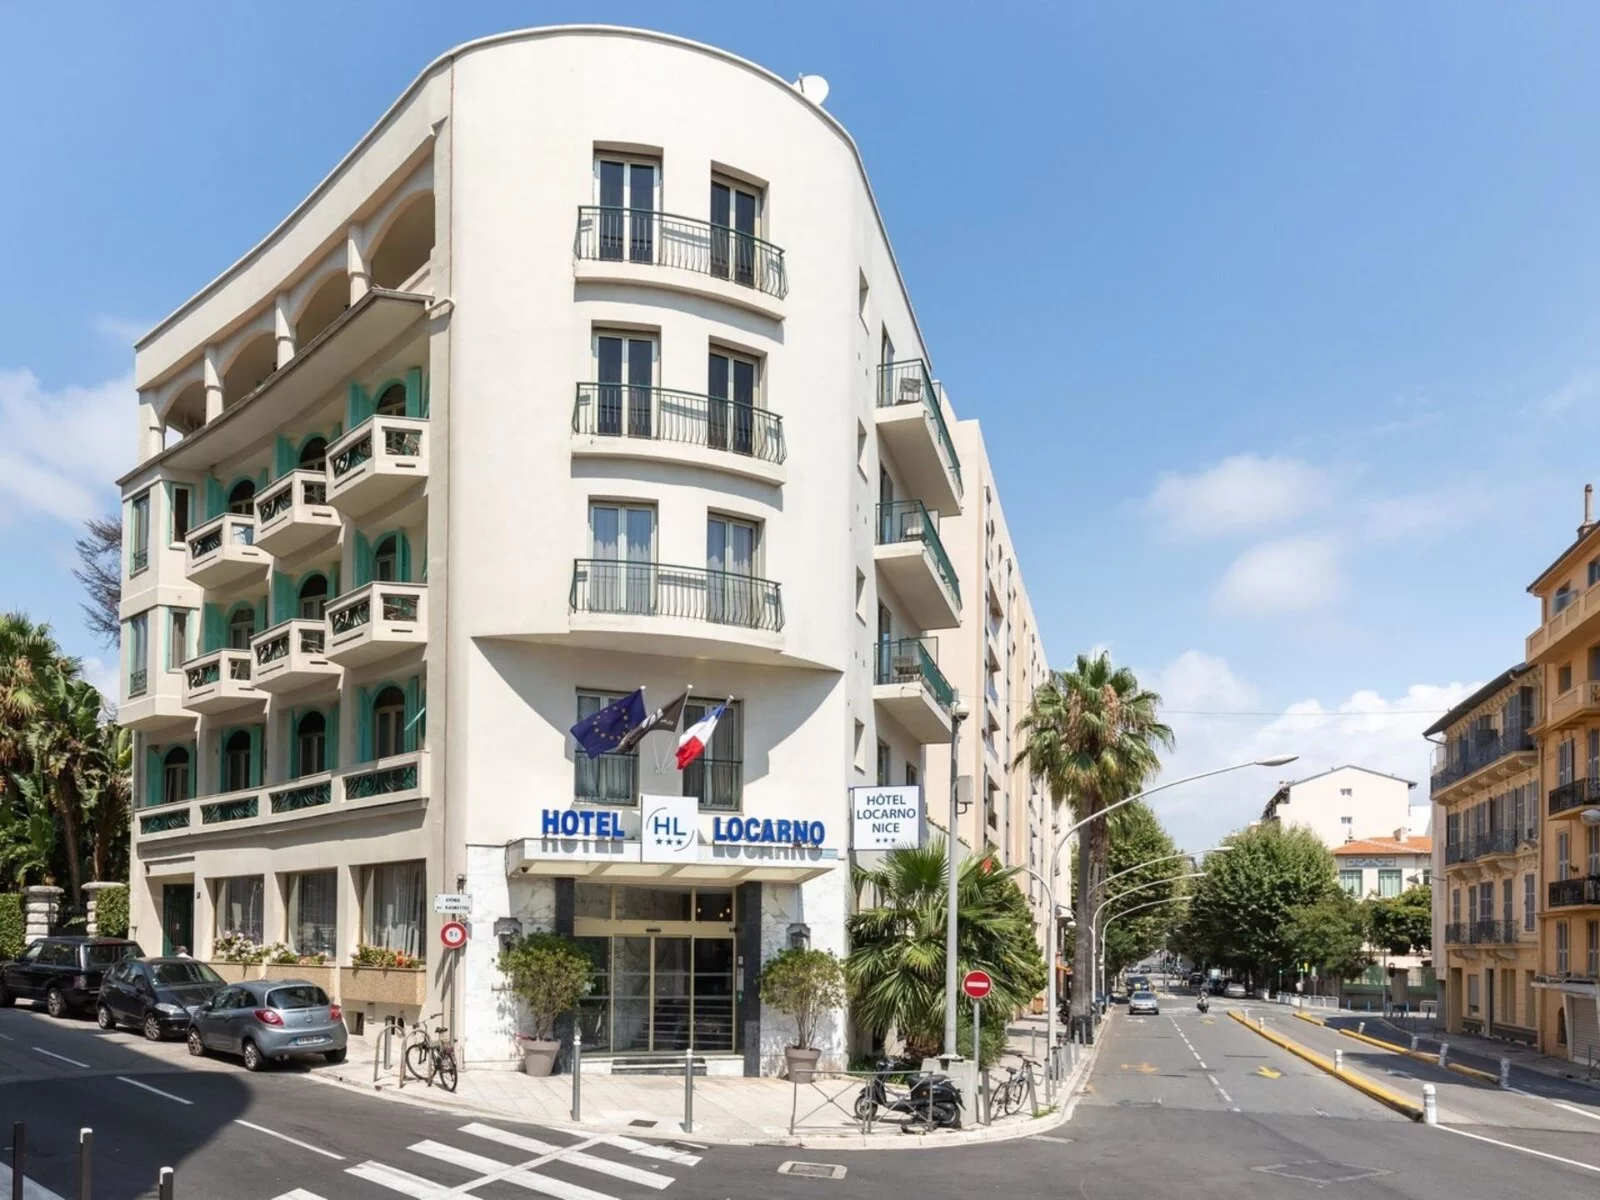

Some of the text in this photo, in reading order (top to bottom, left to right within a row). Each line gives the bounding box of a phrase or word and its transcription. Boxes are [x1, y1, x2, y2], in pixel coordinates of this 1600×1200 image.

[867, 793, 906, 806] HÔTEL
[857, 808, 916, 820] LOCARNO
[542, 809, 825, 845] HOTEL LOCARNO
[654, 816, 687, 836] HL
[872, 823, 900, 833] NICE
